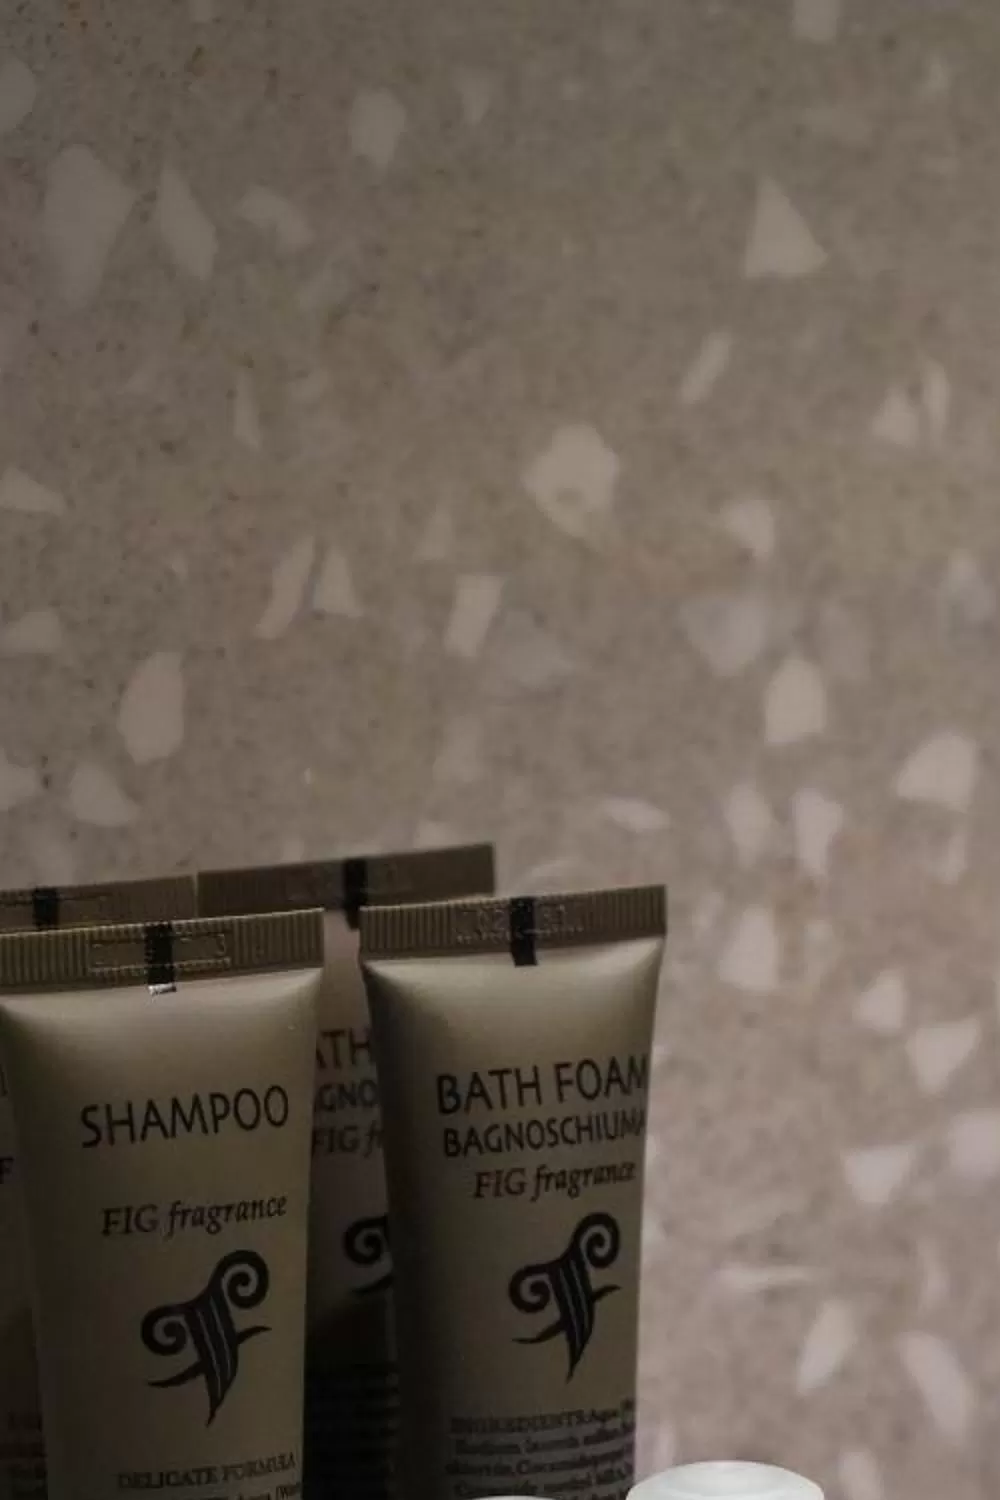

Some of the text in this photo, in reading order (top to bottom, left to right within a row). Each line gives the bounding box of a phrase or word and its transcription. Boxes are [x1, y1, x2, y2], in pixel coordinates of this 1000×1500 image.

[436, 1065, 543, 1115] BATH
[80, 1085, 289, 1149] SHAMPOO
[473, 1162, 636, 1202] FIG fragrance
[101, 1196, 287, 1241] FIG fragrance
[118, 1465, 218, 1489] DELICATE
